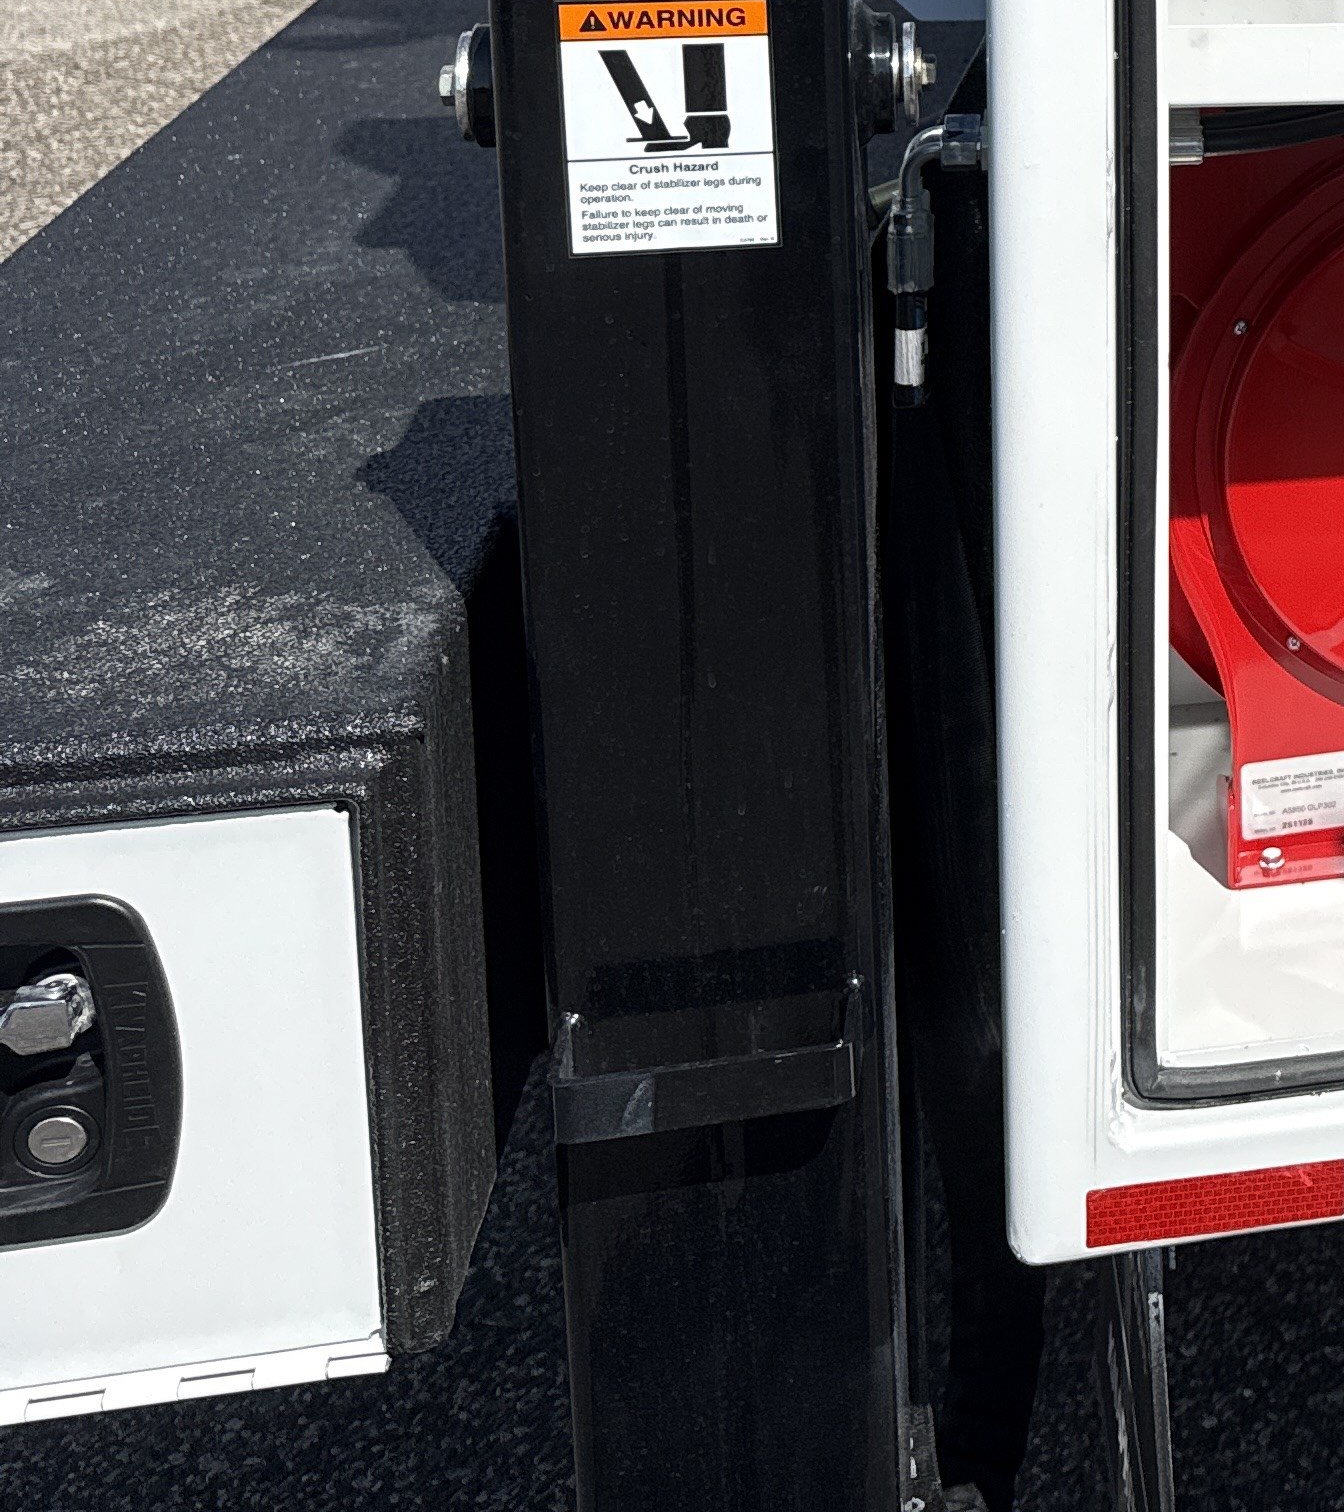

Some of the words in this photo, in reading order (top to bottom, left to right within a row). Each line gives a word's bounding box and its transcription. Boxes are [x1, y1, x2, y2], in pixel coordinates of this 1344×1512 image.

[607, 7, 746, 29] WARNING
[629, 163, 669, 175] Crush
[673, 161, 719, 172] Hazard
[580, 183, 608, 195] Keep
[611, 181, 638, 192] clear
[640, 180, 652, 190] of
[654, 178, 701, 189] stabilizer
[703, 177, 725, 190] legs
[728, 175, 762, 188] during
[580, 193, 634, 205] operation.
[581, 209, 618, 220] Failure
[620, 208, 632, 218] to
[634, 207, 661, 219] keep
[664, 205, 690, 215] clear
[692, 204, 703, 214] of
[705, 202, 744, 215] moving
[581, 219, 630, 232] stabilizer
[632, 219, 655, 232] legs
[657, 217, 677, 227] can
[680, 215, 710, 226] result
[712, 215, 721, 225] in
[724, 213, 753, 224] death
[756, 213, 768, 223] or
[582, 232, 622, 243] serious
[624, 230, 656, 243] injury.
